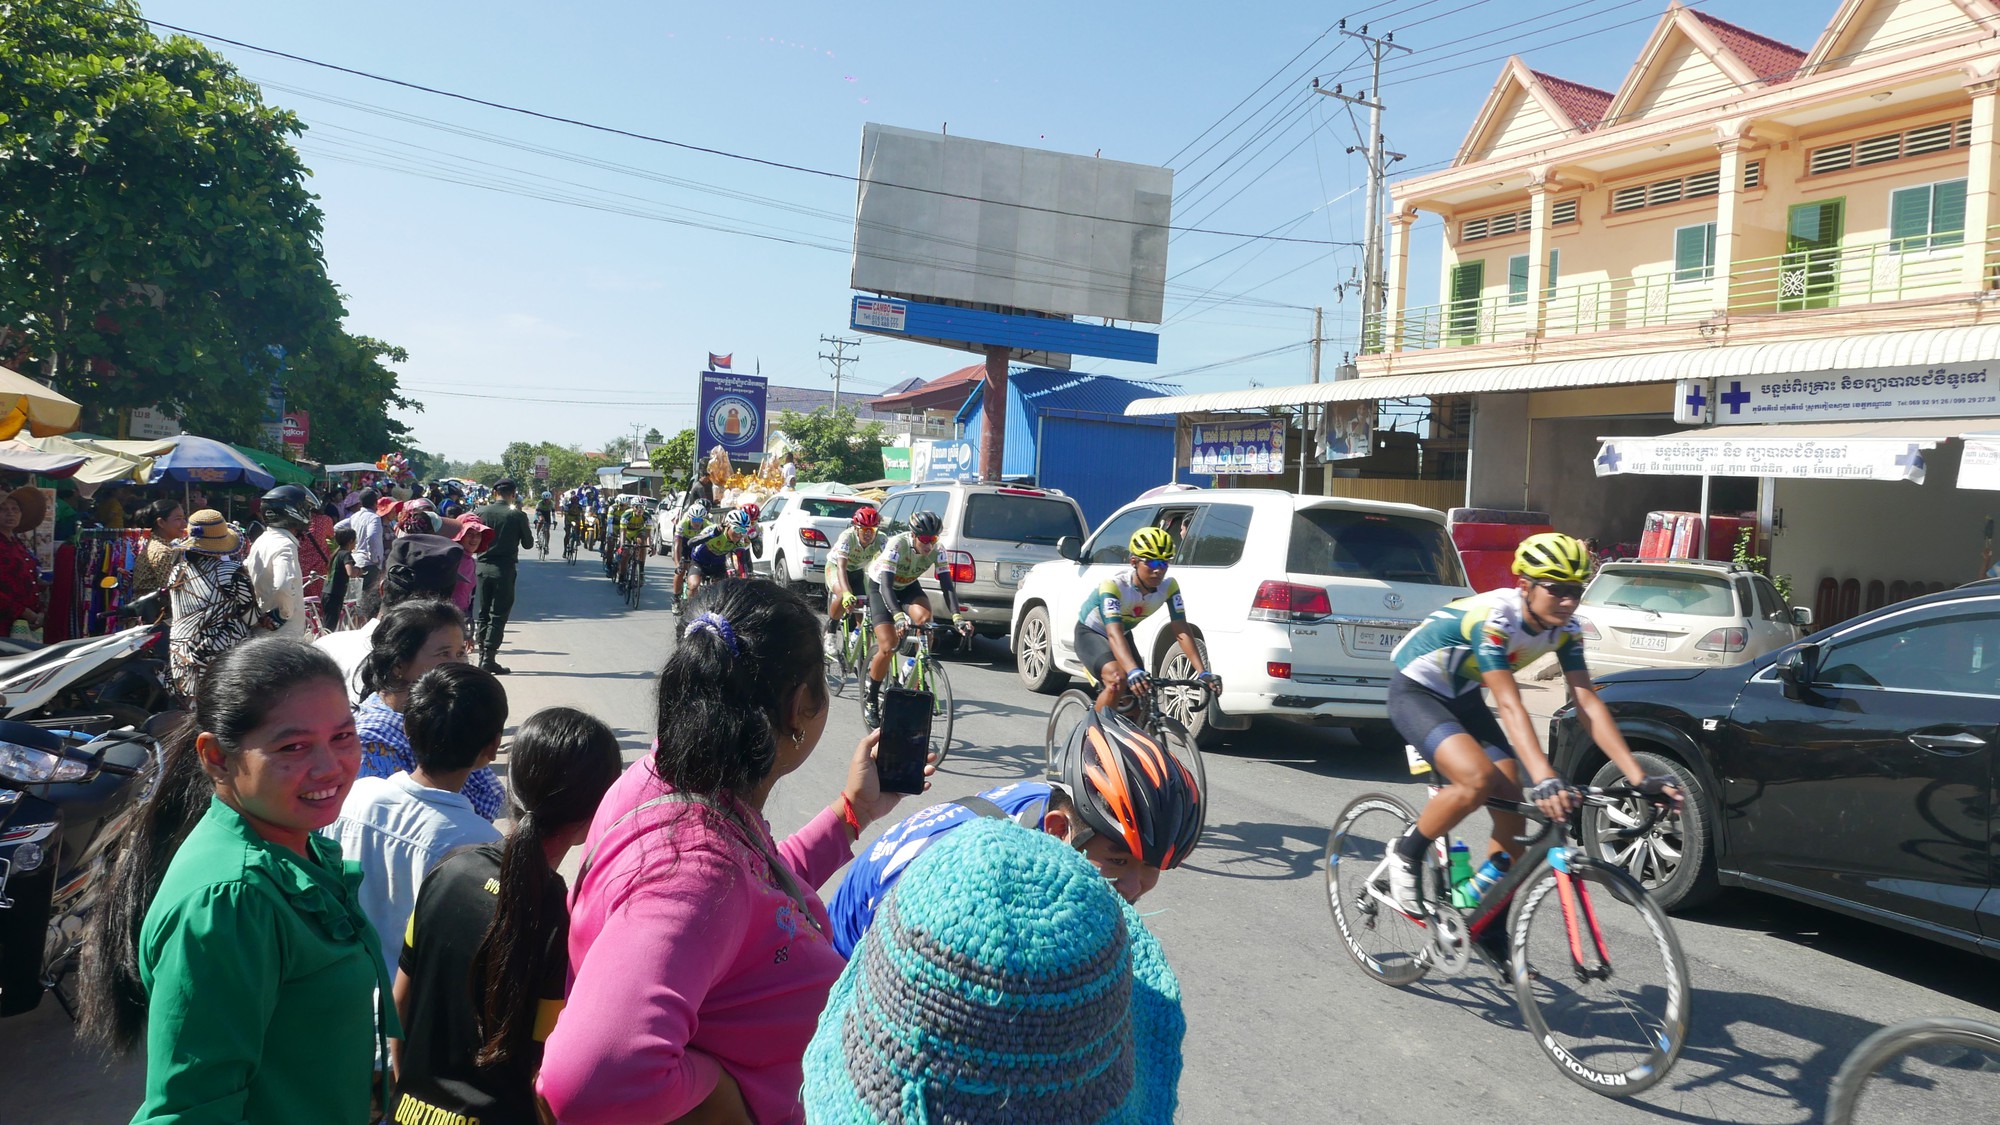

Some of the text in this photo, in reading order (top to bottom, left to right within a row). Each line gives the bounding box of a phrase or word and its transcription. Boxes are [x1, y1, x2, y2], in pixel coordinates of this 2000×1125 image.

[873, 303, 891, 313] CAMBO
[1380, 633, 1405, 646] 2AY-2
[1543, 1034, 1627, 1086] REYNOLDS
